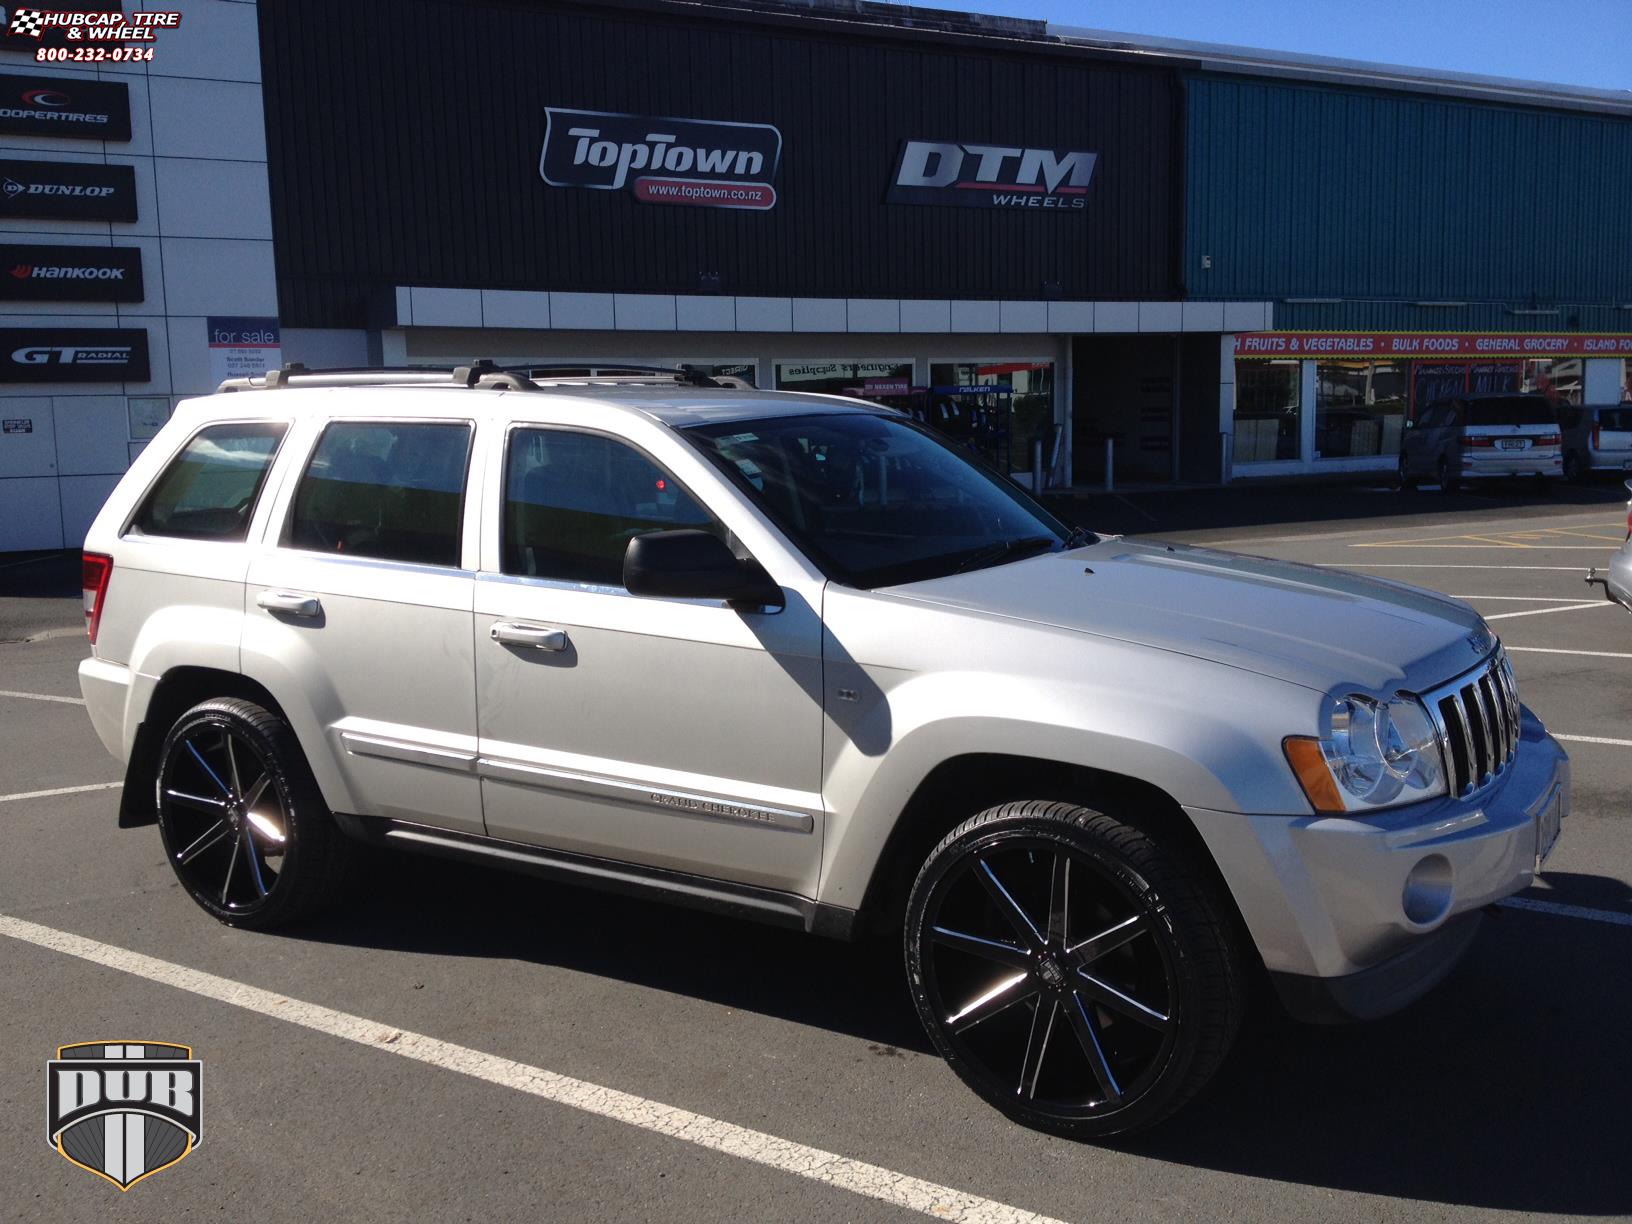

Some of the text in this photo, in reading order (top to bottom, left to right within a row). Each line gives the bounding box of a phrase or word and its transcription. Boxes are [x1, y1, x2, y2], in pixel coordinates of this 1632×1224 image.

[896, 141, 1098, 195] DTM
[27, 184, 115, 197] DUNLOP
[648, 185, 762, 201] www.toptown.co.nz
[992, 194, 1086, 209] WHEELS
[214, 329, 275, 344] for sale
[1244, 338, 1286, 350] FRUITS
[1289, 338, 1299, 350] &
[1303, 338, 1374, 350] VEGETABLES
[1392, 338, 1420, 350] BULK
[1422, 338, 1459, 350] FOODS
[1475, 338, 1521, 350] GENERAL
[1523, 338, 1569, 350] GROCERY
[1583, 338, 1617, 350] ISLAND
[11, 347, 82, 364] GT
[650, 793, 776, 822] GRAND CHEROKEE
